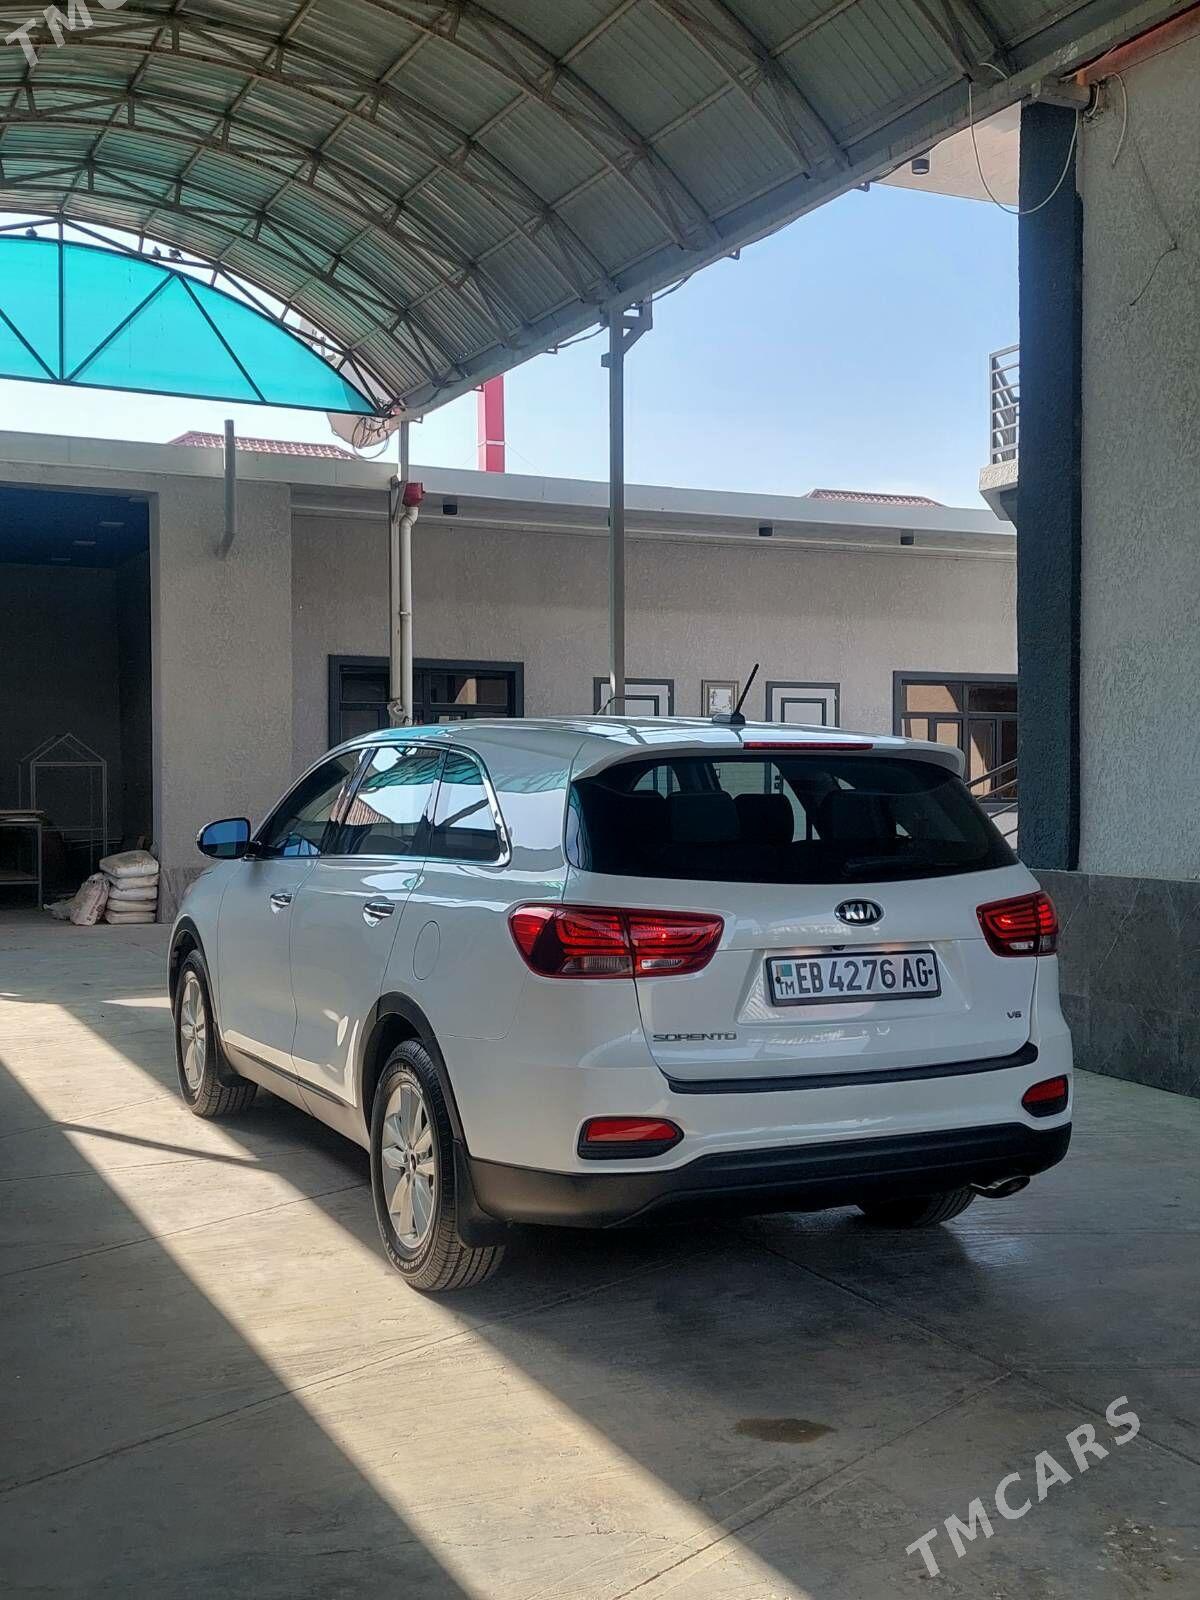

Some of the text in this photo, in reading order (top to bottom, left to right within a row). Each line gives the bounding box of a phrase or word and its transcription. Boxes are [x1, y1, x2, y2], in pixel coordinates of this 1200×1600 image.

[843, 903, 878, 920] KIA
[795, 957, 929, 994] EB 4276 AG
[779, 981, 795, 995] TM
[1006, 1010, 1022, 1018] V6
[653, 1032, 737, 1042] SORENTO
